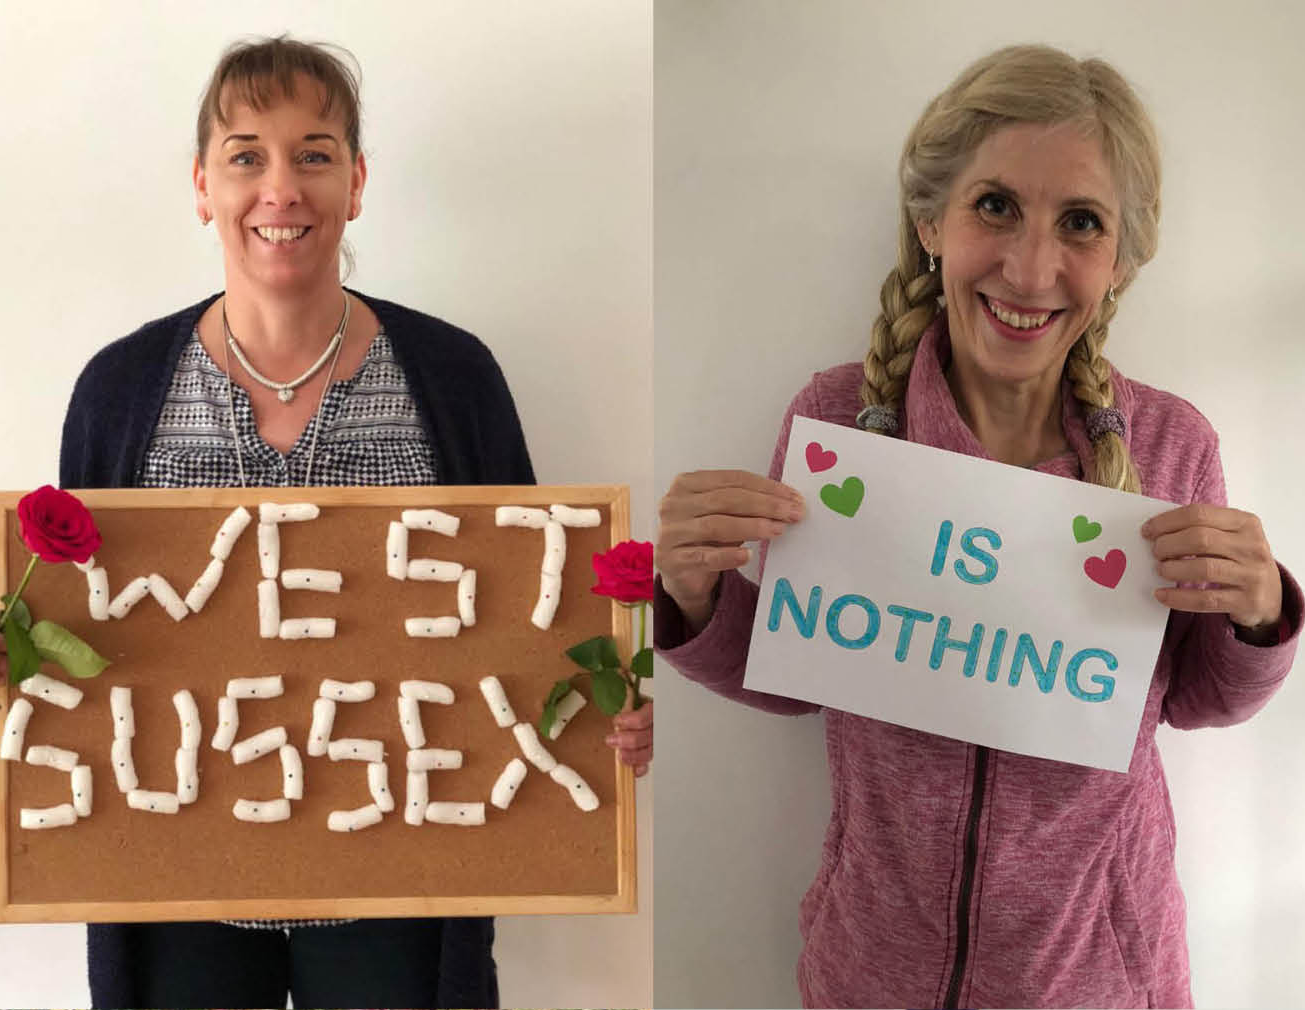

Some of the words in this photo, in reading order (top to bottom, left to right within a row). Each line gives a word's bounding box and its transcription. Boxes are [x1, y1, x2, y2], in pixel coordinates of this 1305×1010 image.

[74, 502, 602, 639] WEST
[930, 519, 1002, 585] IS
[767, 577, 1119, 703] NOTHING
[0, 674, 600, 832] SUSSEX
